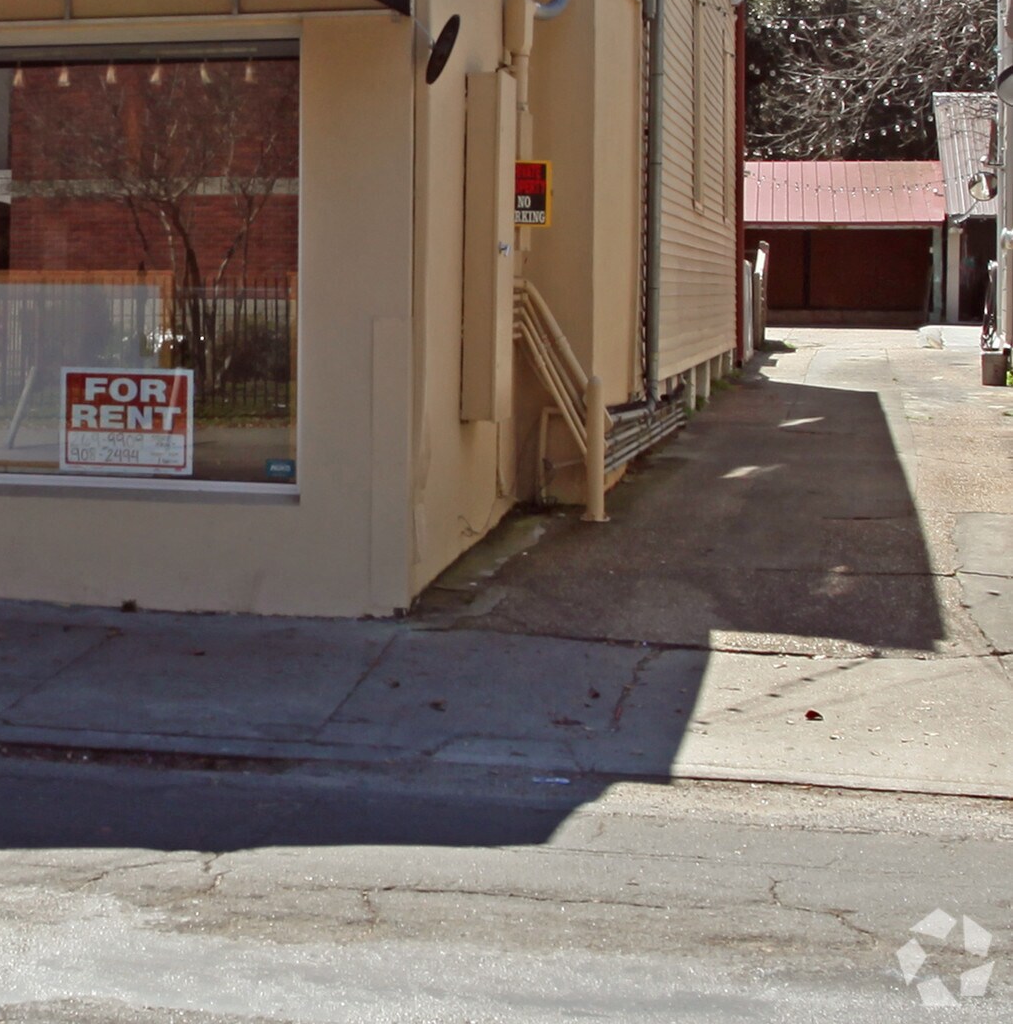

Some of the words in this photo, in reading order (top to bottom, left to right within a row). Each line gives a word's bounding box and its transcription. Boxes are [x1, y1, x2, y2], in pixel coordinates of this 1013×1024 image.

[517, 195, 531, 209] NO
[515, 210, 545, 224] RKING
[84, 377, 168, 404] FOR
[70, 404, 183, 432] RENT
